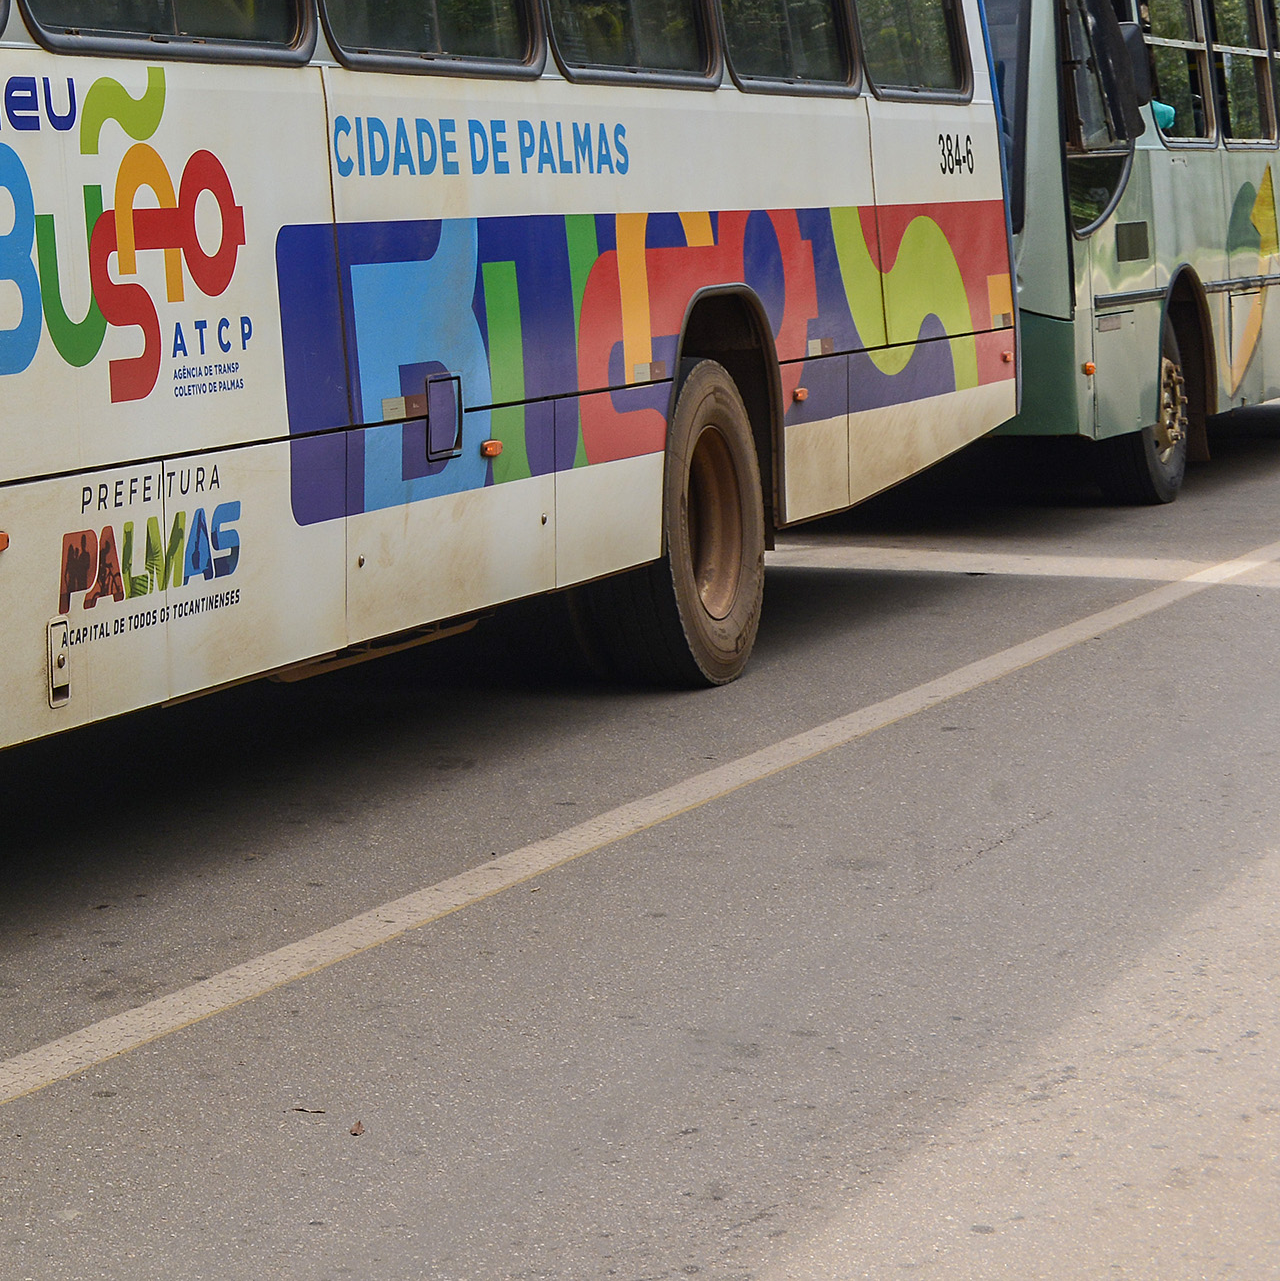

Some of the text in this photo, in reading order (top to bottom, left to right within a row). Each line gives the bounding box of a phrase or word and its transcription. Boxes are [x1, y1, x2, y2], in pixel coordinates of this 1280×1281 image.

[333, 115, 630, 178] CIDADE DE PALMAS
[938, 133, 975, 175] 384-6
[173, 361, 240, 380] AGÊNCIA DE TRANSP
[173, 377, 245, 398] COLETIVO DE PALMAS
[80, 463, 221, 515] PREFEITURA
[58, 500, 242, 615] PALMAS
[61, 588, 241, 649] A CAPITAL DE TODOS OS TOCANTINENSES
